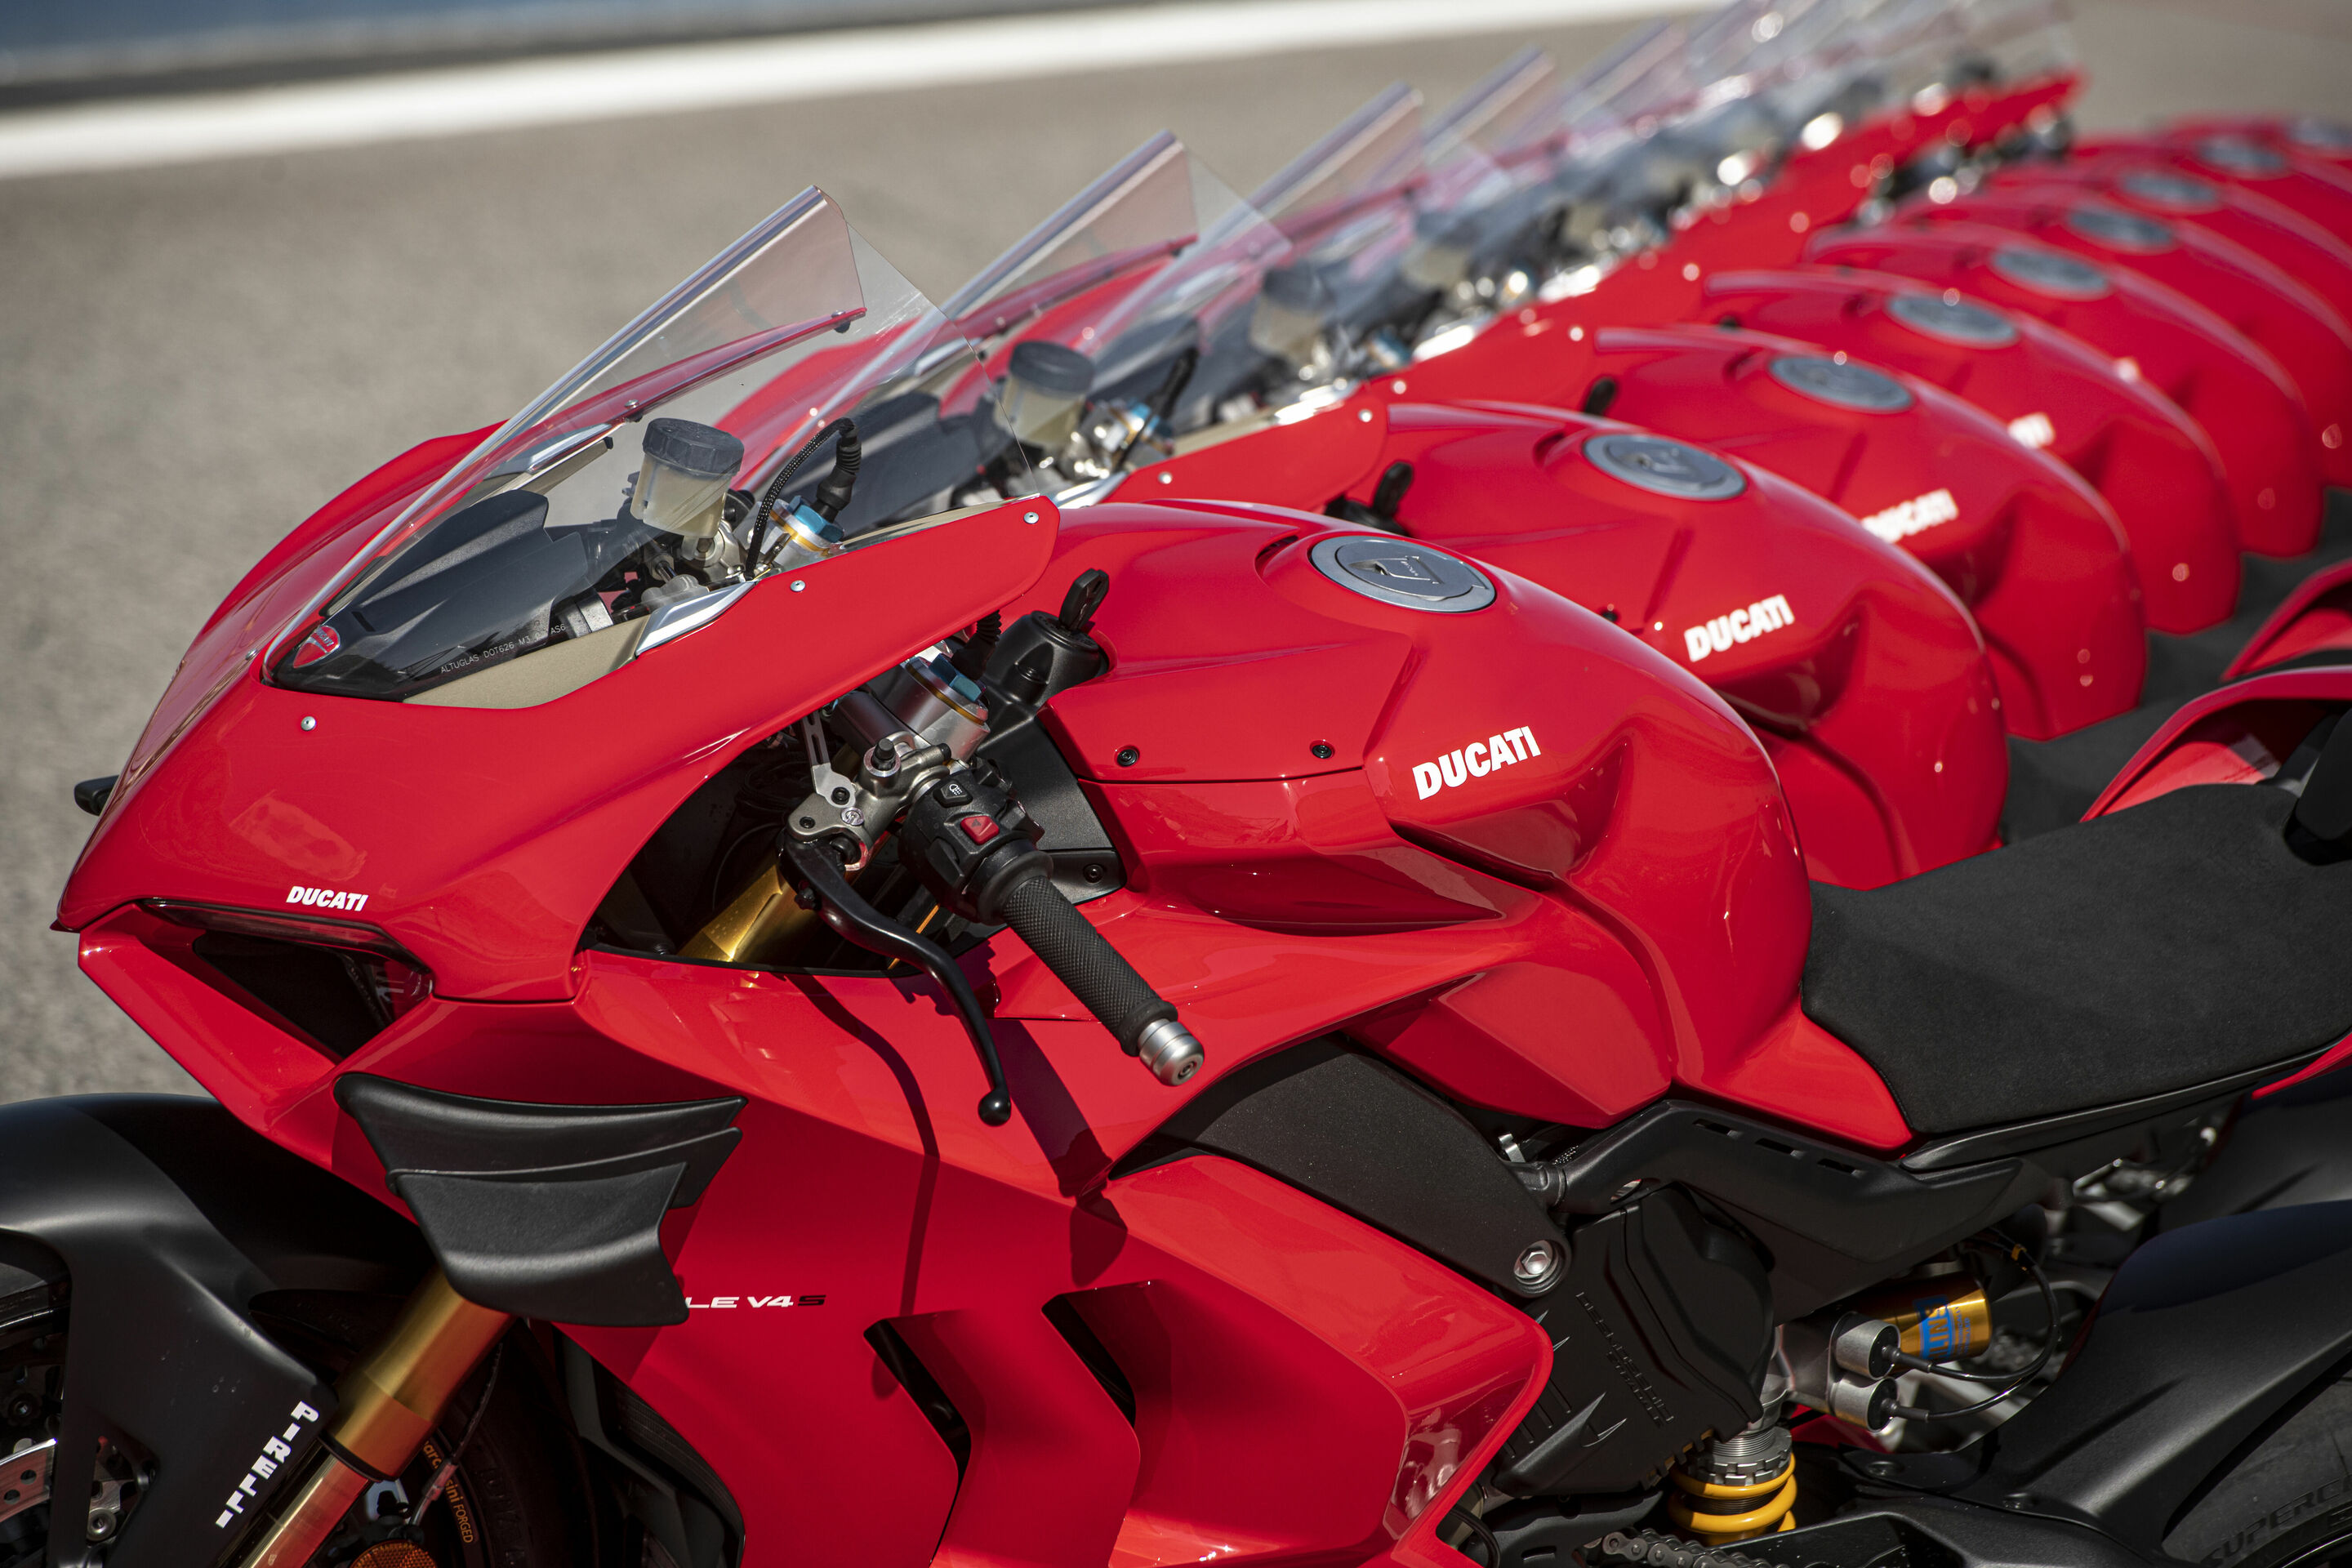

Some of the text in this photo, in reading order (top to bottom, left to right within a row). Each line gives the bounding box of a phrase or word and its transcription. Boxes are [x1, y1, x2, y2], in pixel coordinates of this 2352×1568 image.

[1684, 594, 1795, 662] DUCATI
[441, 654, 480, 674] ALTUGLAS
[483, 641, 514, 658] DOT626
[1412, 726, 1541, 800] DUCATI
[285, 885, 369, 911] DUCATI
[216, 1401, 319, 1529] PIRELLI
[453, 1503, 474, 1544] FORGED
